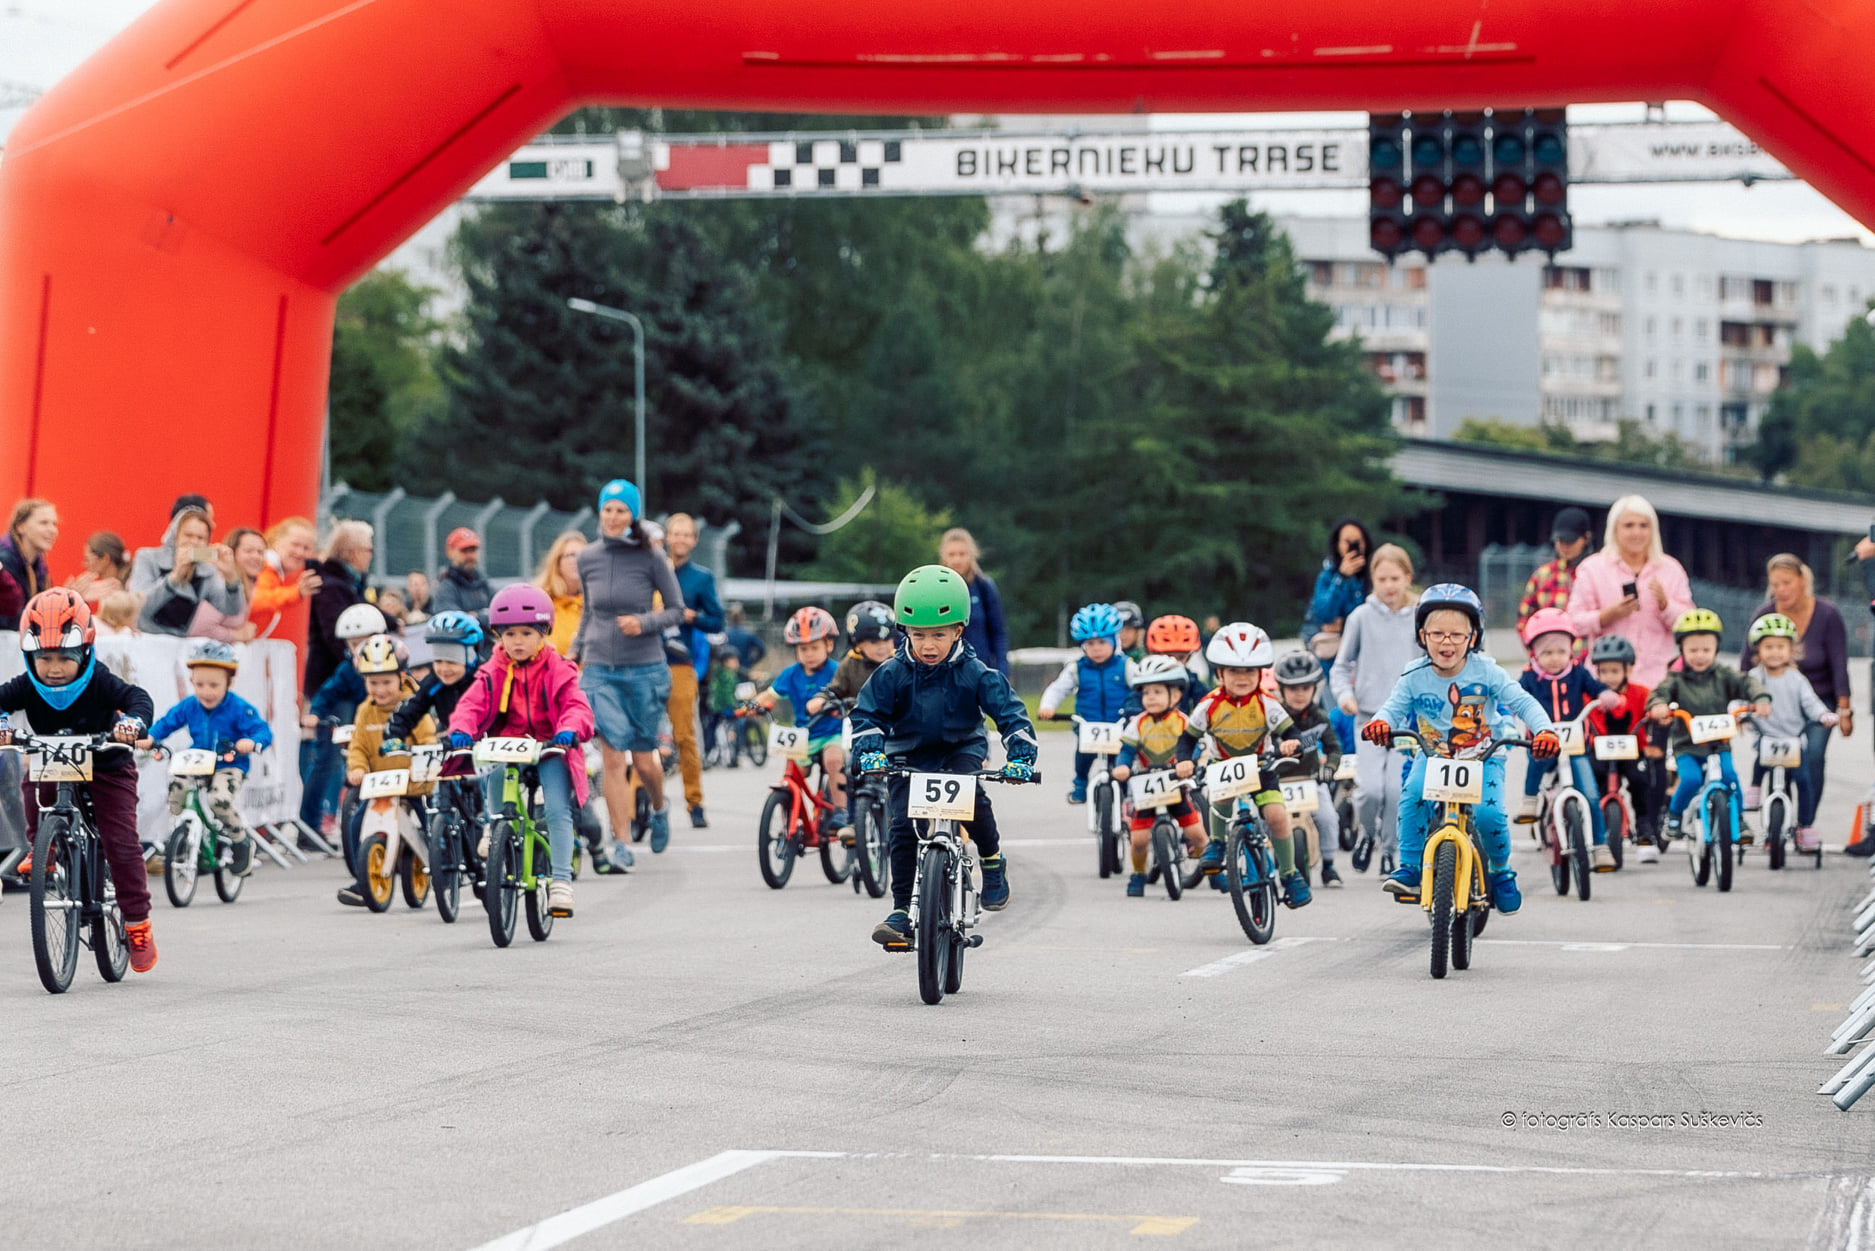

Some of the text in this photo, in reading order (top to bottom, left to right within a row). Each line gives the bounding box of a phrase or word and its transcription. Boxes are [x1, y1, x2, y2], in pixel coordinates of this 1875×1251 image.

[1212, 144, 1341, 173] TRASE
[777, 732, 797, 747] 49
[1091, 727, 1111, 742] 91
[40, 743, 86, 765] 140
[488, 740, 528, 752] 146
[370, 774, 402, 788] 141
[1220, 763, 1245, 783] 40
[1441, 765, 1469, 787] 10
[925, 779, 960, 803] 59
[1144, 778, 1166, 795] 41
[1284, 785, 1305, 800] 31
